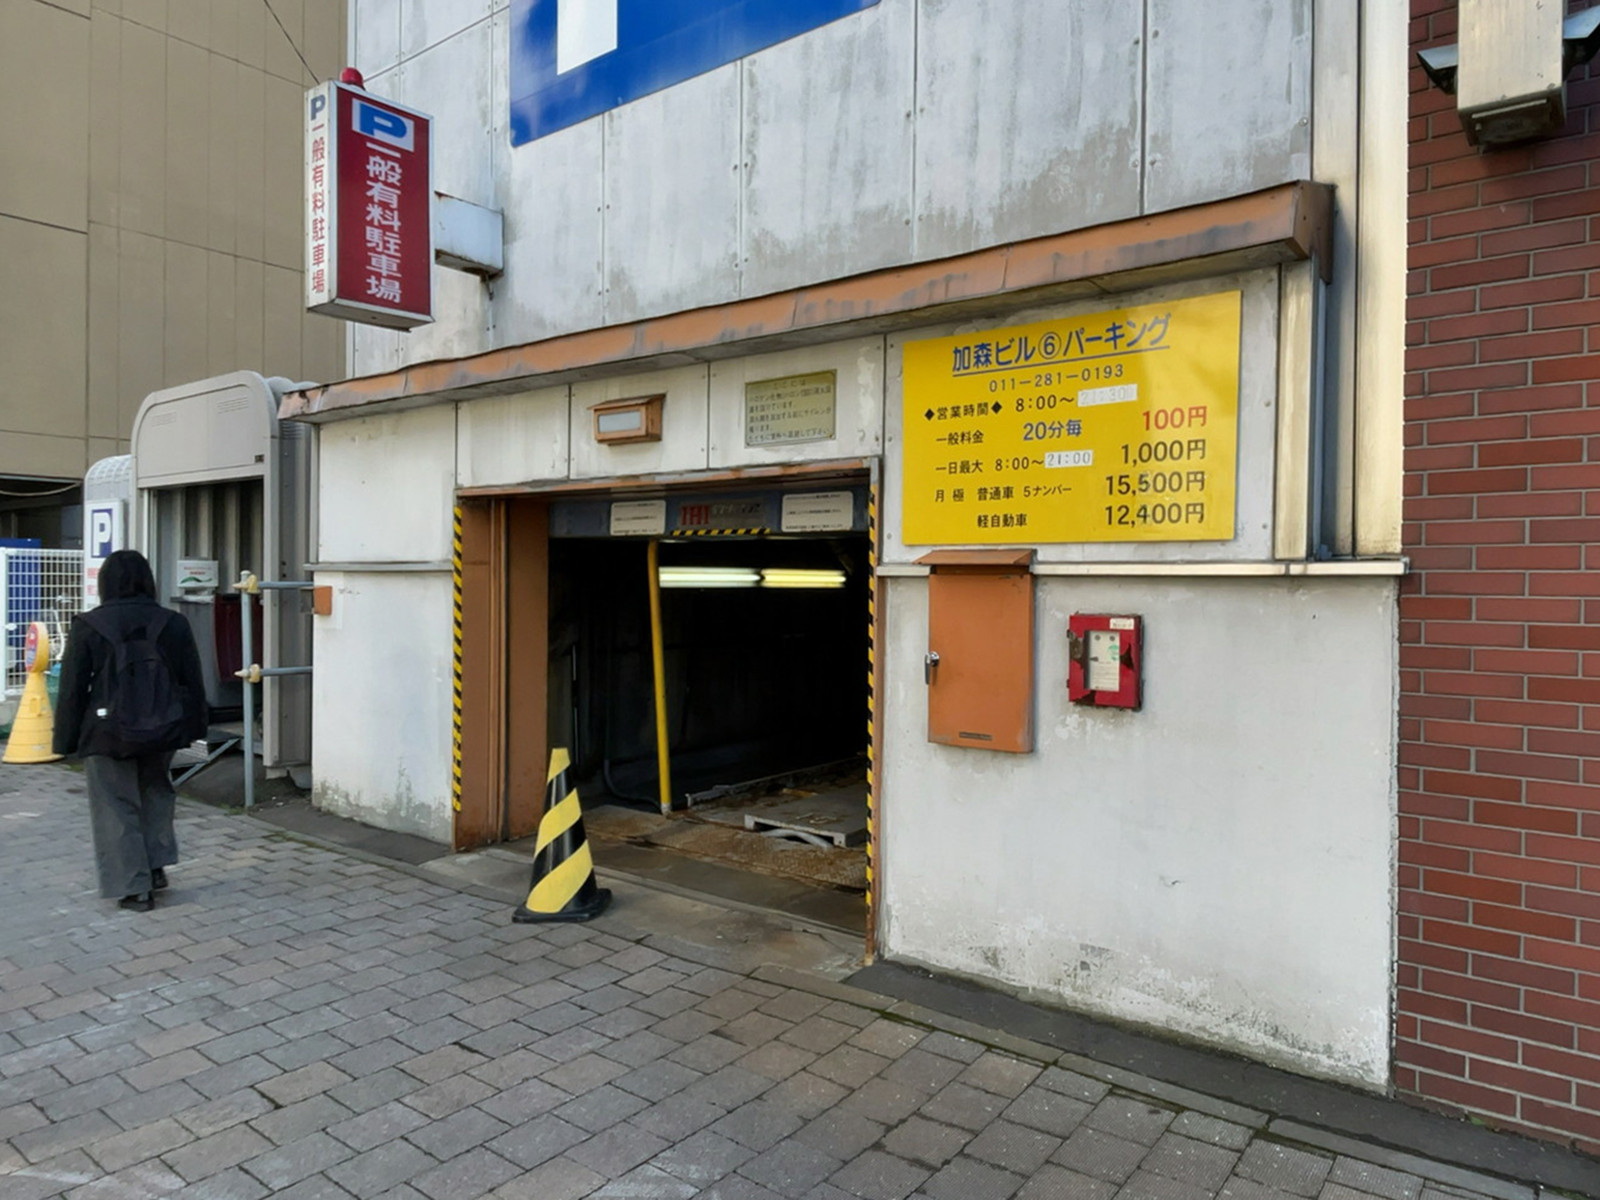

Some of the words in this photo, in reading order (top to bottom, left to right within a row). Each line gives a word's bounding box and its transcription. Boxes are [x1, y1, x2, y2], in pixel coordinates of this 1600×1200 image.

[310, 94, 325, 121] P
[359, 102, 407, 139] P
[366, 141, 402, 303] 一般有料駐車場
[936, 430, 985, 446] 一般料金
[1023, 419, 1082, 441] 20分毎
[1142, 405, 1208, 431] 100円
[936, 459, 983, 474] 一日最大
[1121, 438, 1207, 467] 1,000円
[977, 486, 1015, 501] 普通車
[1105, 470, 1206, 497] 15,500円
[977, 512, 1028, 528] 軽自動車
[1104, 502, 1206, 528] 12,400円
[92, 511, 112, 556] P
